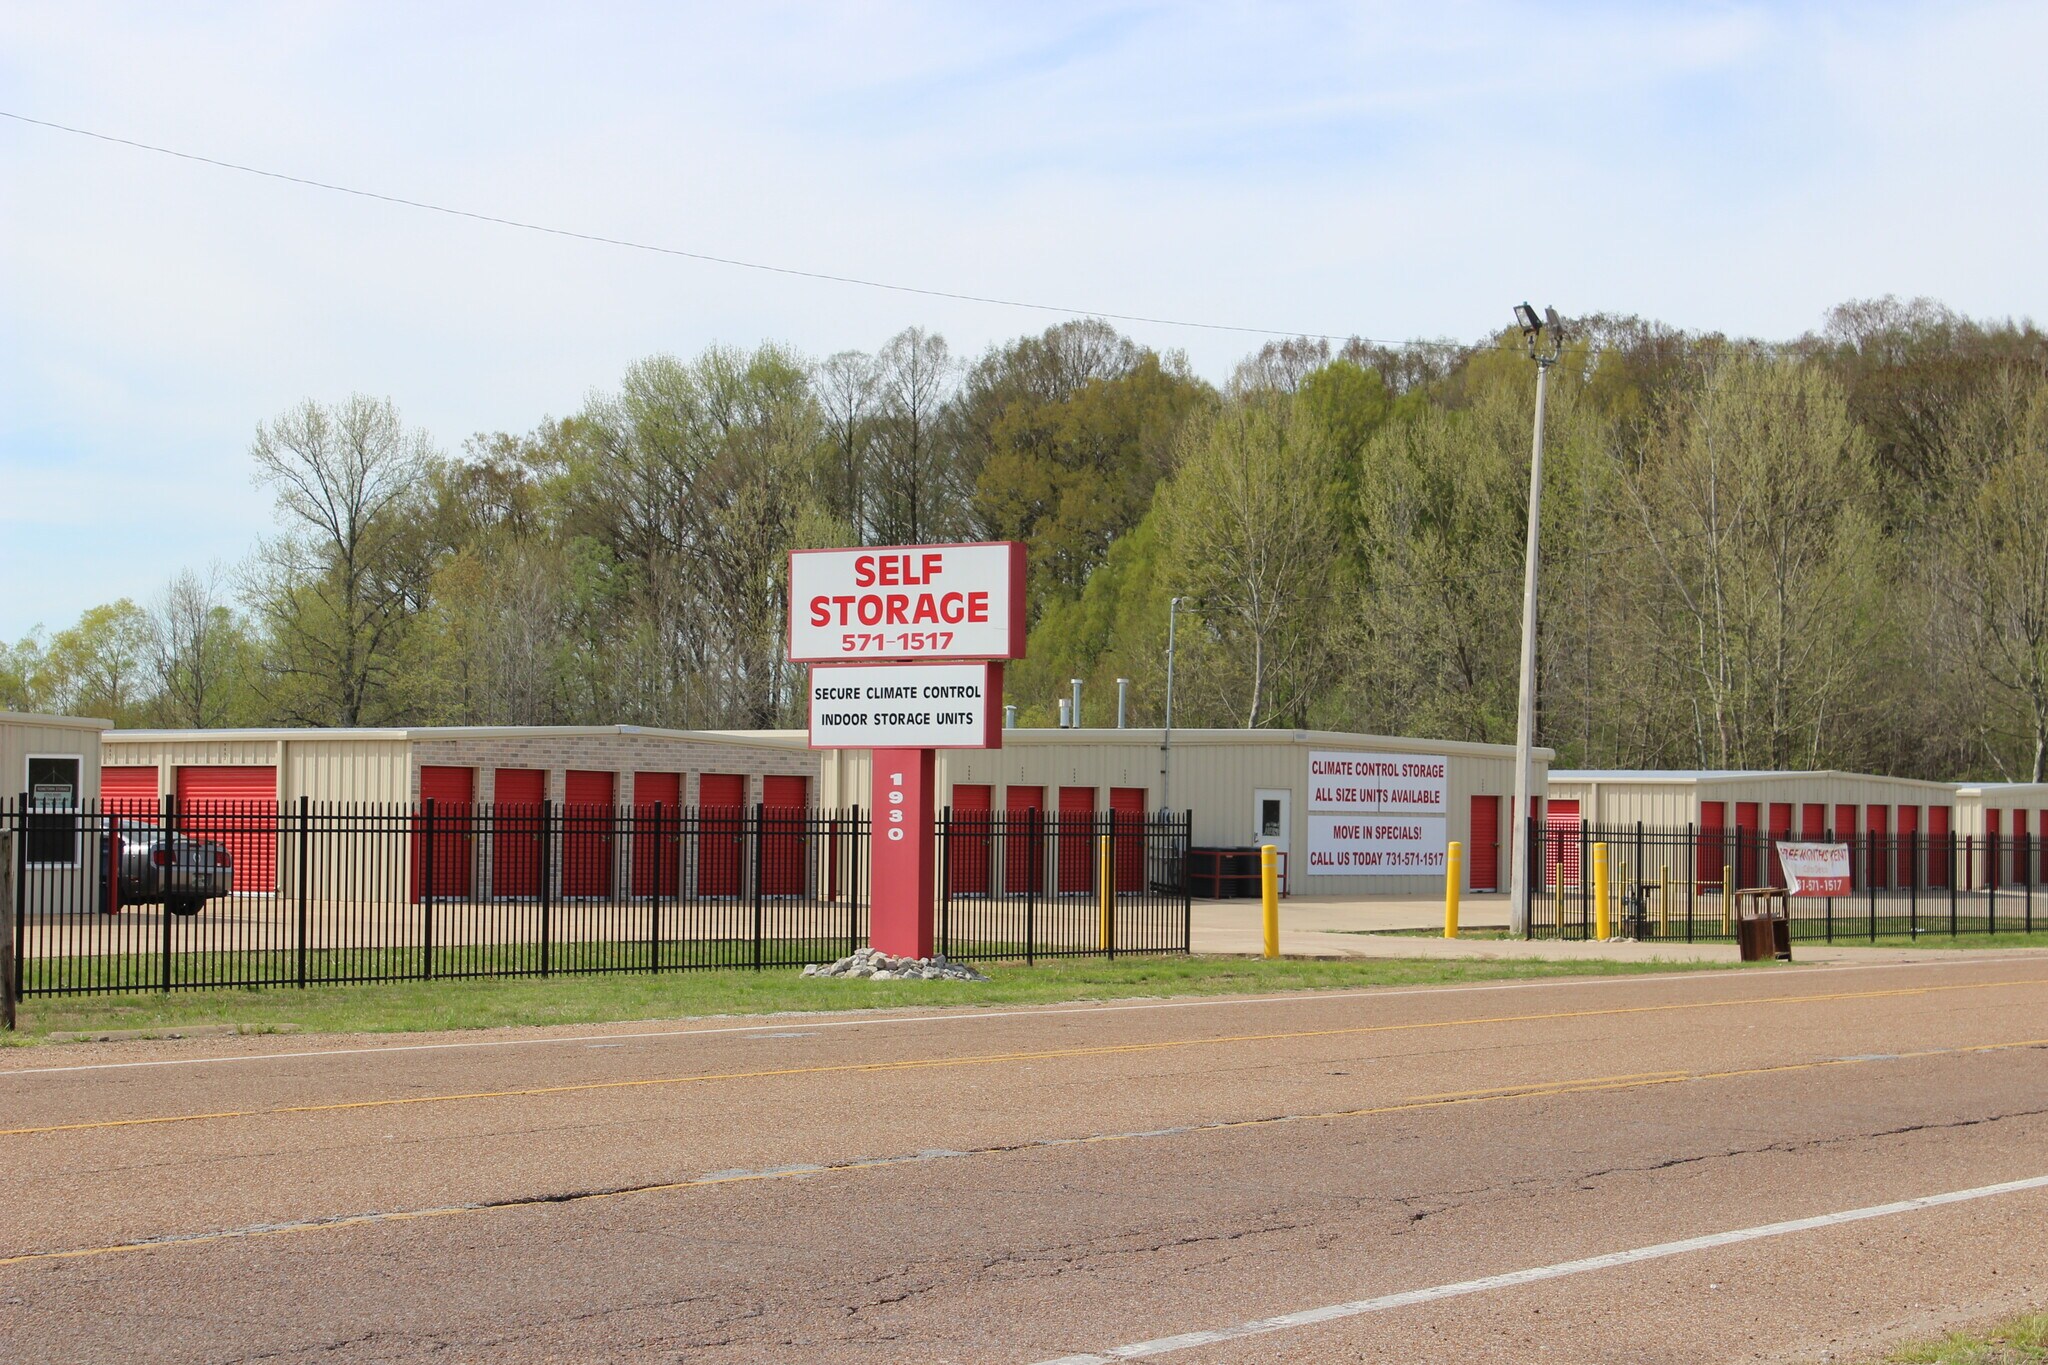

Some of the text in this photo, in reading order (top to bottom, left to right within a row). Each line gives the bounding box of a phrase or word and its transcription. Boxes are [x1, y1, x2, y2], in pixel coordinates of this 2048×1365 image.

[855, 554, 942, 587] SELF
[810, 591, 989, 627] STORAGE
[842, 631, 954, 651] 571-1517
[815, 685, 981, 700] SECURE CLIMATE CONTROL
[821, 712, 973, 726] INDOOR STORAGE UNITS
[1312, 760, 1444, 778] CLIMATE CONTROL STORAGE
[1315, 787, 1440, 804] ALL SIZE UNITS AVAILABLE
[888, 773, 903, 841] 1930
[1333, 825, 1422, 840] MOVE IN SPECIALS!
[1310, 852, 1444, 866] CALL US TODAY 731-571-1517
